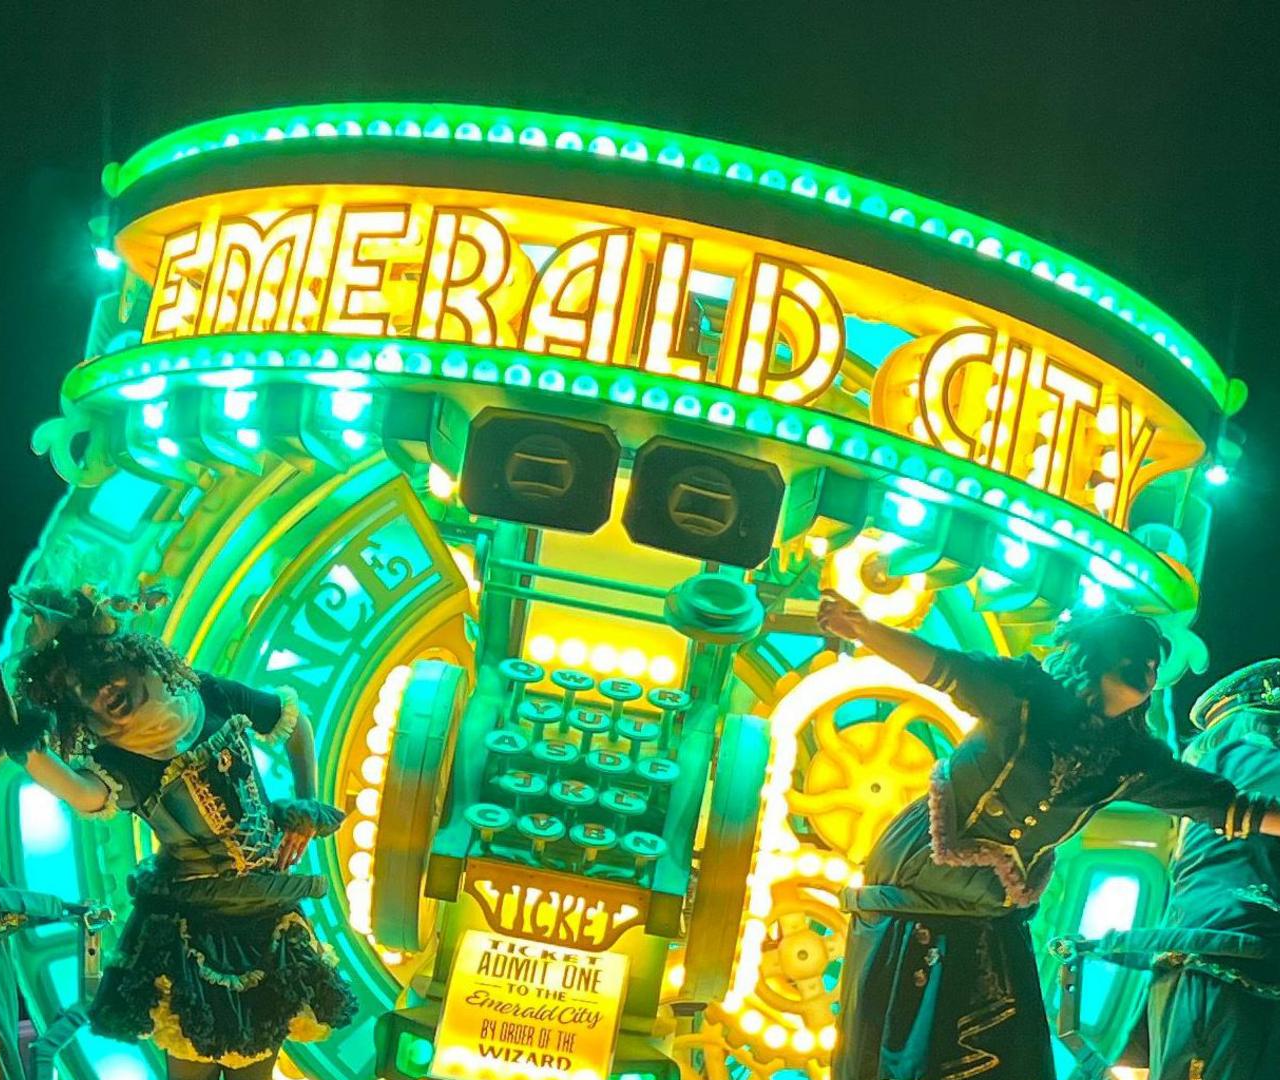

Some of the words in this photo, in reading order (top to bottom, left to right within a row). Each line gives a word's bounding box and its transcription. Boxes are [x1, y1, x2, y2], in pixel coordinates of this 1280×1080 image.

[141, 203, 847, 407] EMERALD
[920, 325, 1157, 530] CITY
[265, 512, 434, 688] NCE
[510, 664, 536, 676] Q
[558, 672, 587, 684] W
[611, 681, 632, 692] E
[658, 690, 681, 703] R
[531, 702, 554, 715] Y
[577, 712, 602, 725] U
[492, 735, 518, 748] A
[546, 743, 567, 758] S
[598, 751, 622, 766] D
[649, 762, 671, 774] F
[561, 783, 587, 799] K
[477, 808, 500, 824] C
[529, 816, 556, 831] V
[583, 823, 606, 841] B
[633, 836, 658, 851] N
[466, 878, 645, 950] TICKET
[487, 938, 603, 966] TICKET
[476, 951, 551, 986] ADMIT
[562, 964, 603, 994] ONE
[465, 989, 557, 1022] Emerald
[558, 1006, 603, 1029] City
[507, 983, 530, 997] TO
[536, 987, 567, 1002] THE
[480, 1018, 497, 1039] BY
[500, 1022, 536, 1045] ORDER
[538, 1028, 551, 1048] OF
[556, 1030, 576, 1054] THE
[478, 1043, 572, 1071] WIZARD
